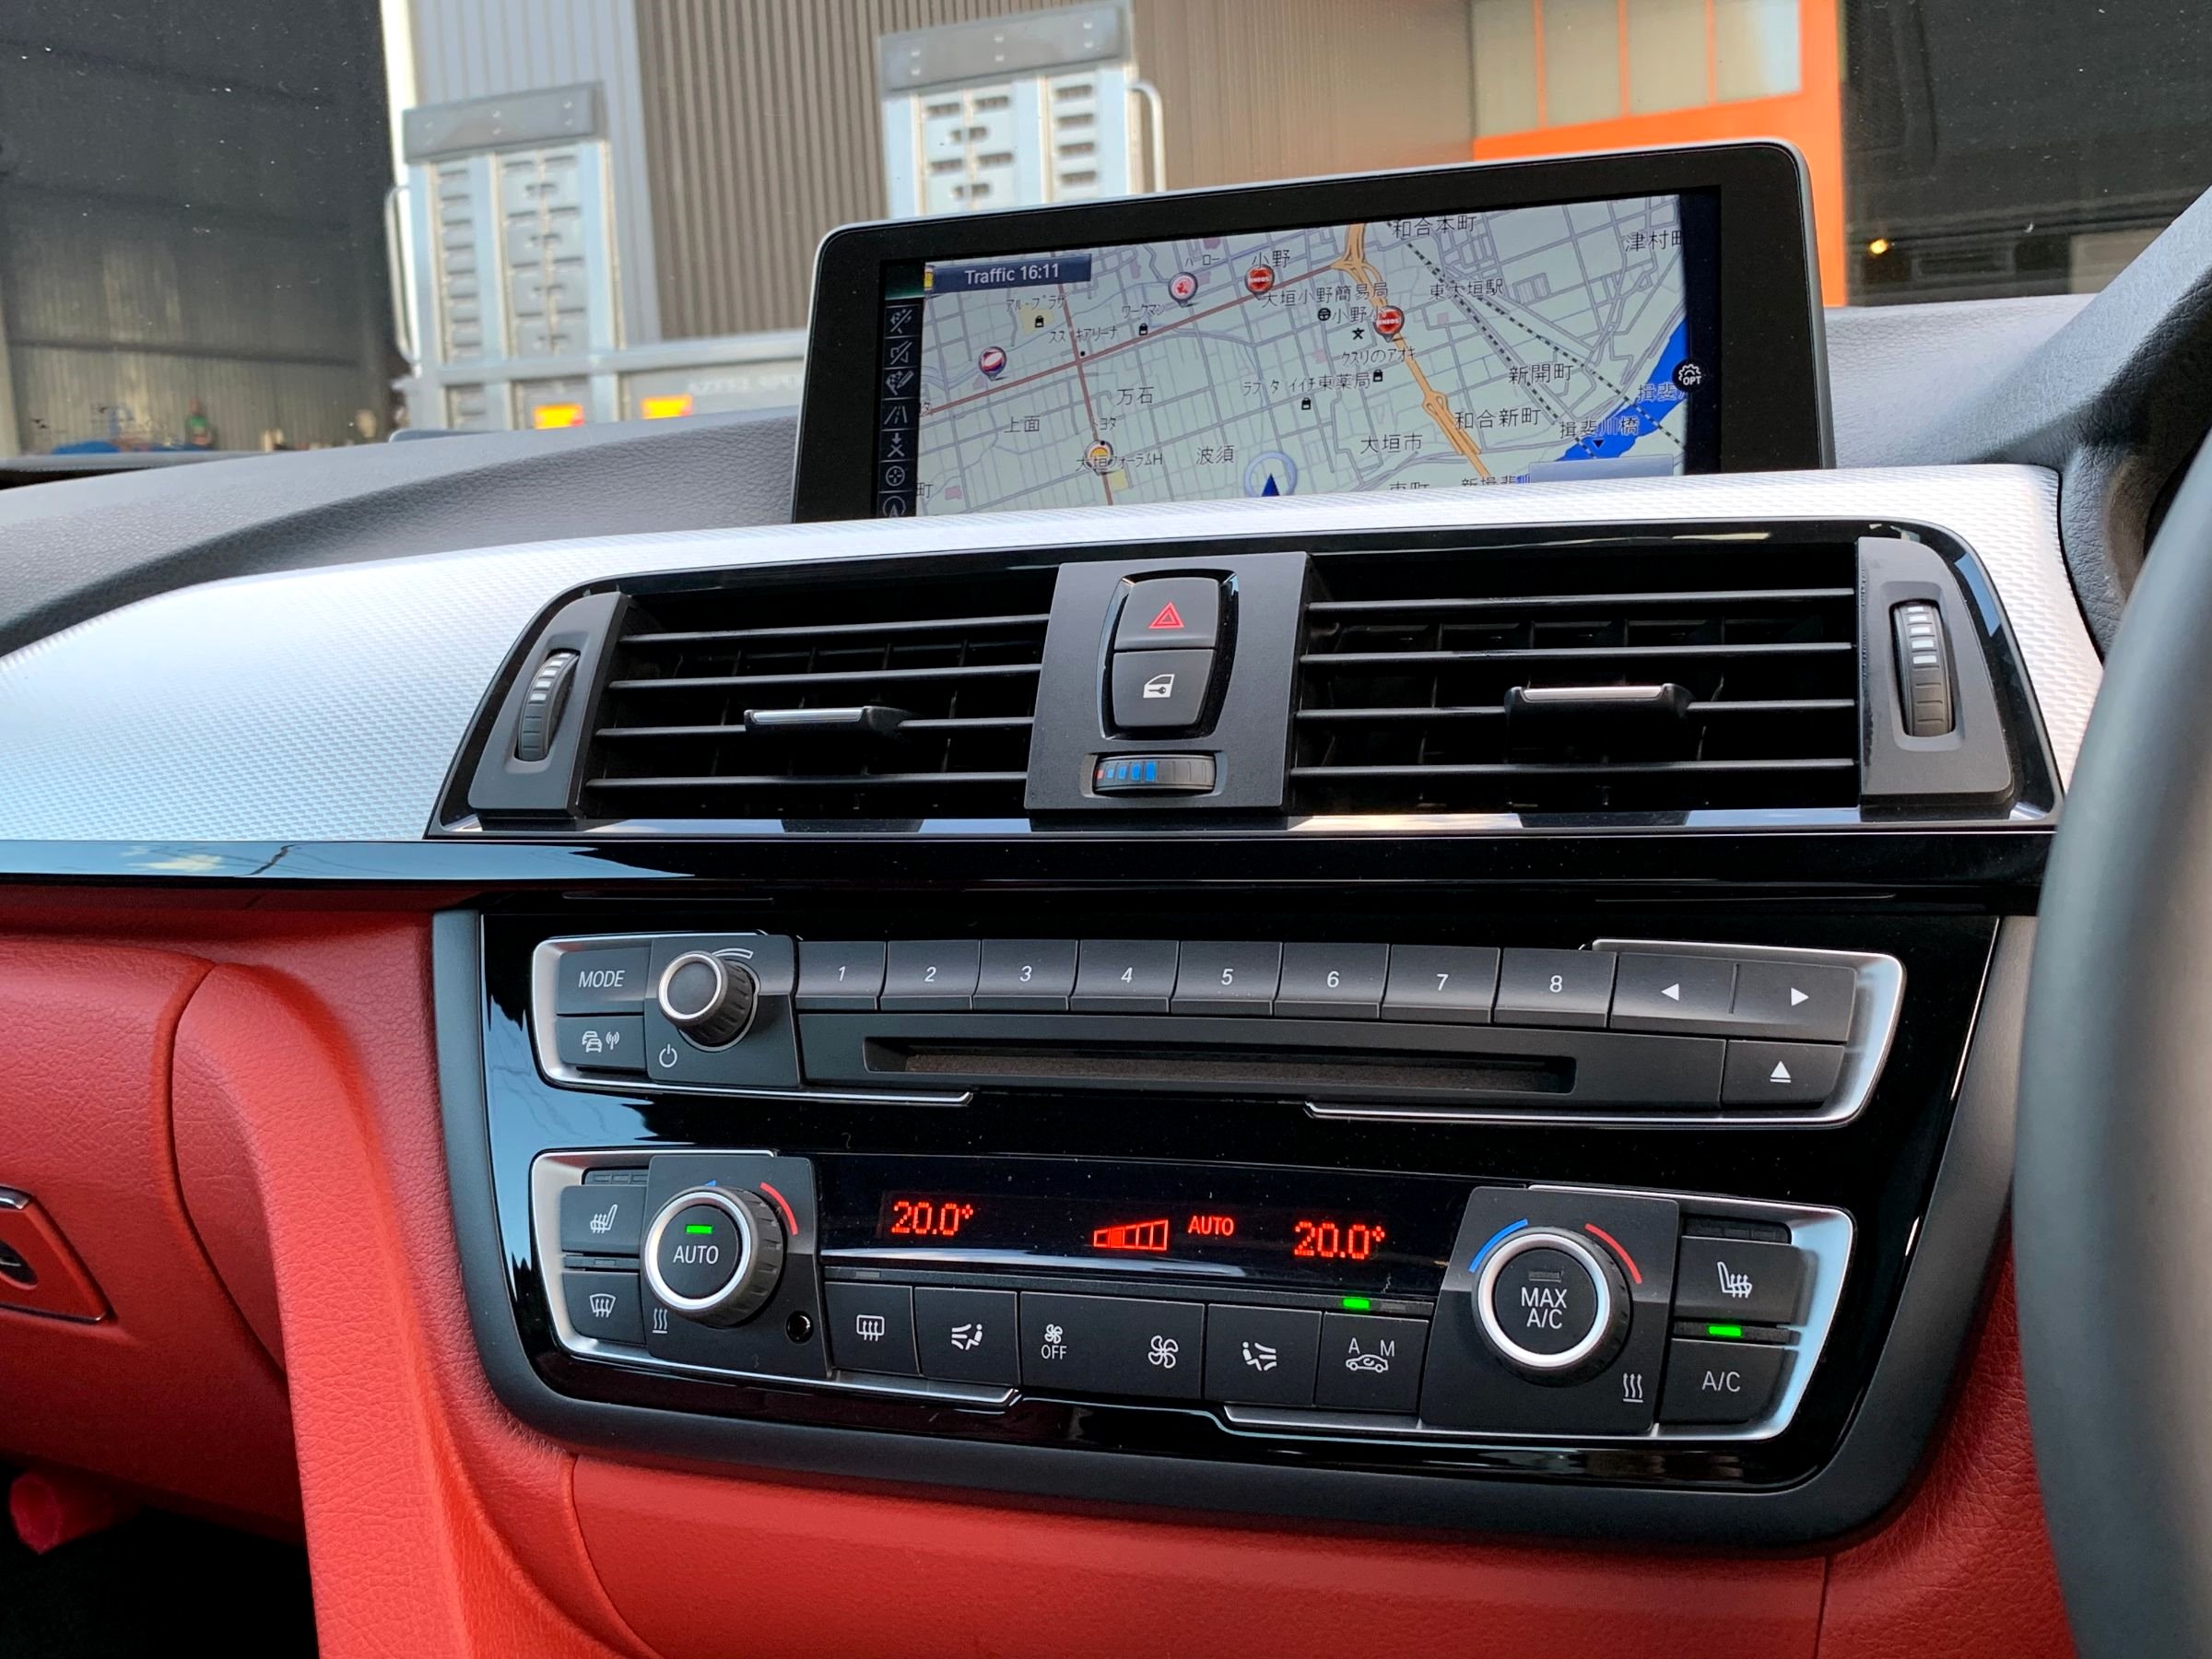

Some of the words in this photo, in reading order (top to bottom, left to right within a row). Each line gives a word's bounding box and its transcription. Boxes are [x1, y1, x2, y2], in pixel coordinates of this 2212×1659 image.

[1393, 214, 1477, 240] 和合本町
[1252, 250, 1291, 268] 小野
[965, 266, 1015, 285] Traffic
[1020, 263, 1059, 280] 16:11
[1430, 278, 1504, 301] 東大垣駅
[1508, 363, 1574, 385] 新開町
[1682, 376, 1702, 386] OPT
[1116, 386, 1156, 406] 万石
[1004, 415, 1041, 433] 上面
[1454, 408, 1542, 429] 和合新町
[1359, 431, 1424, 455] 大垣市
[1195, 445, 1235, 465] 波須
[578, 970, 626, 988] MODE
[838, 966, 847, 982] 1
[924, 966, 936, 982] 2
[1019, 965, 1032, 982] 3
[1120, 967, 1133, 983] 4
[1220, 968, 1234, 986] 5
[1326, 971, 1340, 989] 6
[1436, 973, 1450, 992] 7
[1549, 974, 1563, 994] 8
[890, 1200, 974, 1237] 20.0°
[1187, 1215, 1235, 1237] AUTO
[1293, 1220, 1385, 1260] 20.0°
[672, 1244, 719, 1265] AUTO
[1521, 1287, 1568, 1310] MAX
[1526, 1309, 1564, 1330] A/C
[1041, 1345, 1068, 1360] OFF
[1348, 1337, 1360, 1355] A
[1380, 1340, 1395, 1358] M
[1701, 1371, 1741, 1393] A/C
